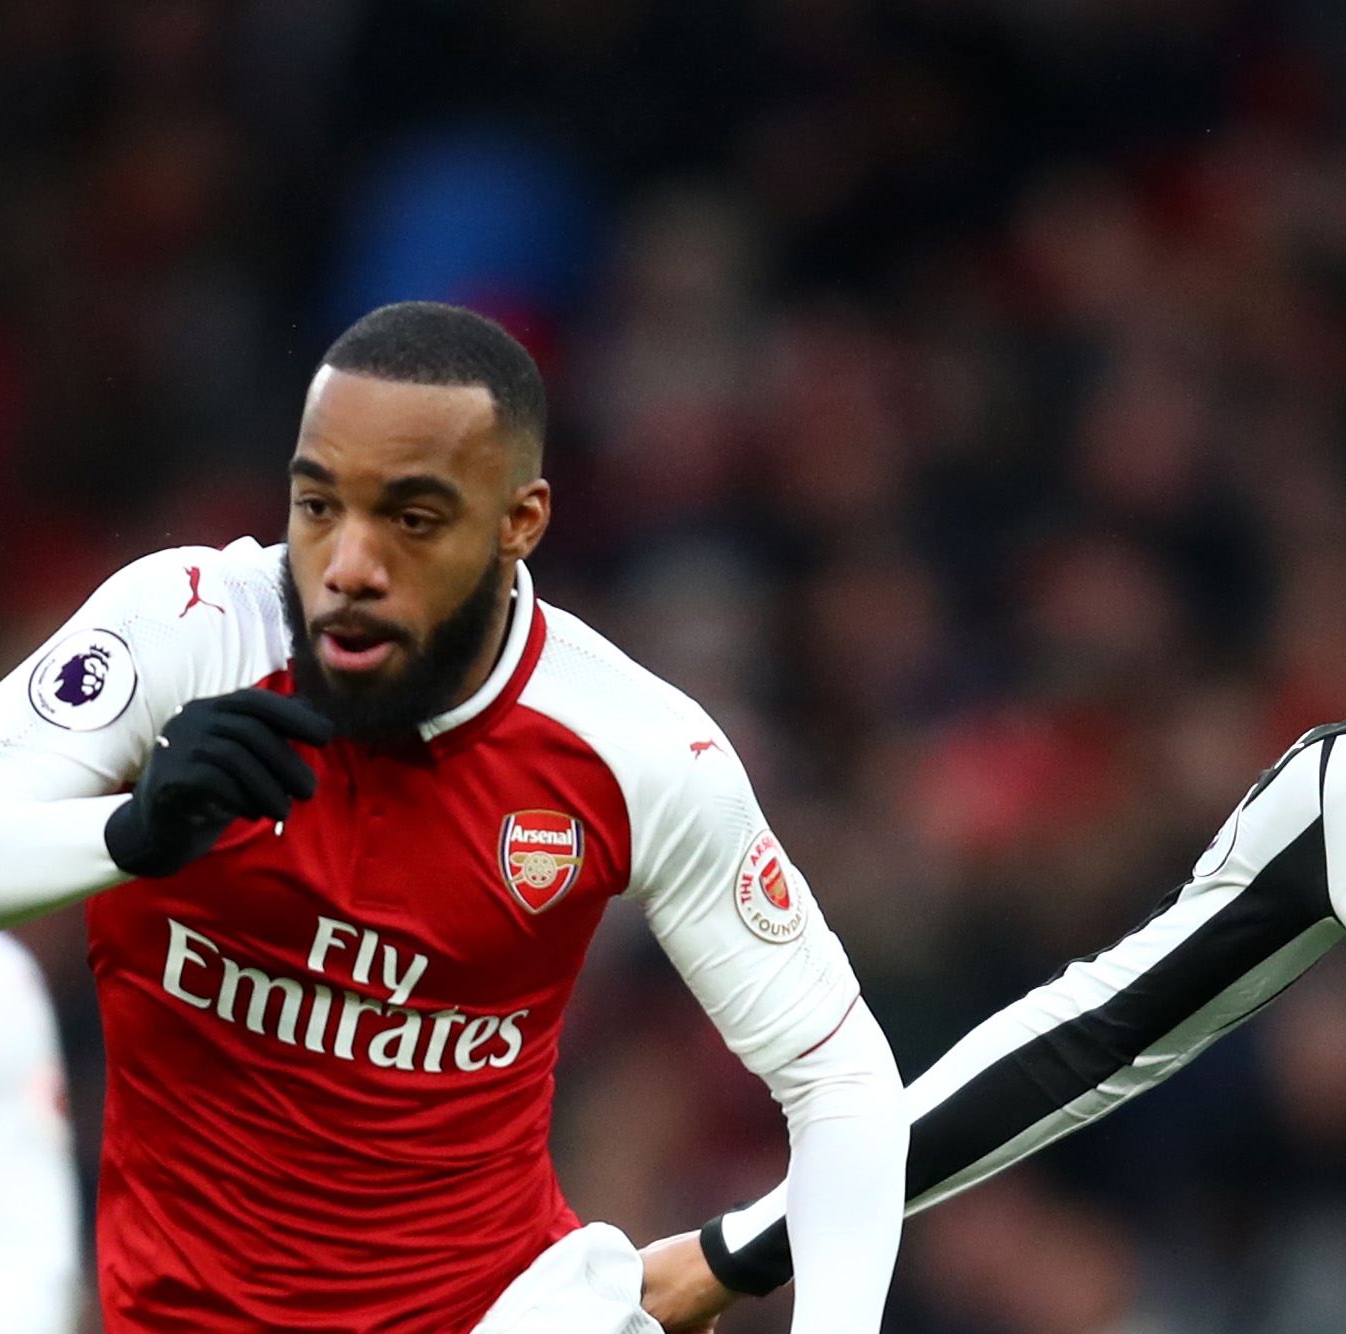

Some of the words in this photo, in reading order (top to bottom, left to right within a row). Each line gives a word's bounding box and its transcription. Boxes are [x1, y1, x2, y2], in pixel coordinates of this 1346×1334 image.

[511, 825, 573, 846] Arsenal
[741, 874, 754, 904] THE
[307, 915, 429, 1005] Fly
[162, 917, 529, 1073] Emirates
